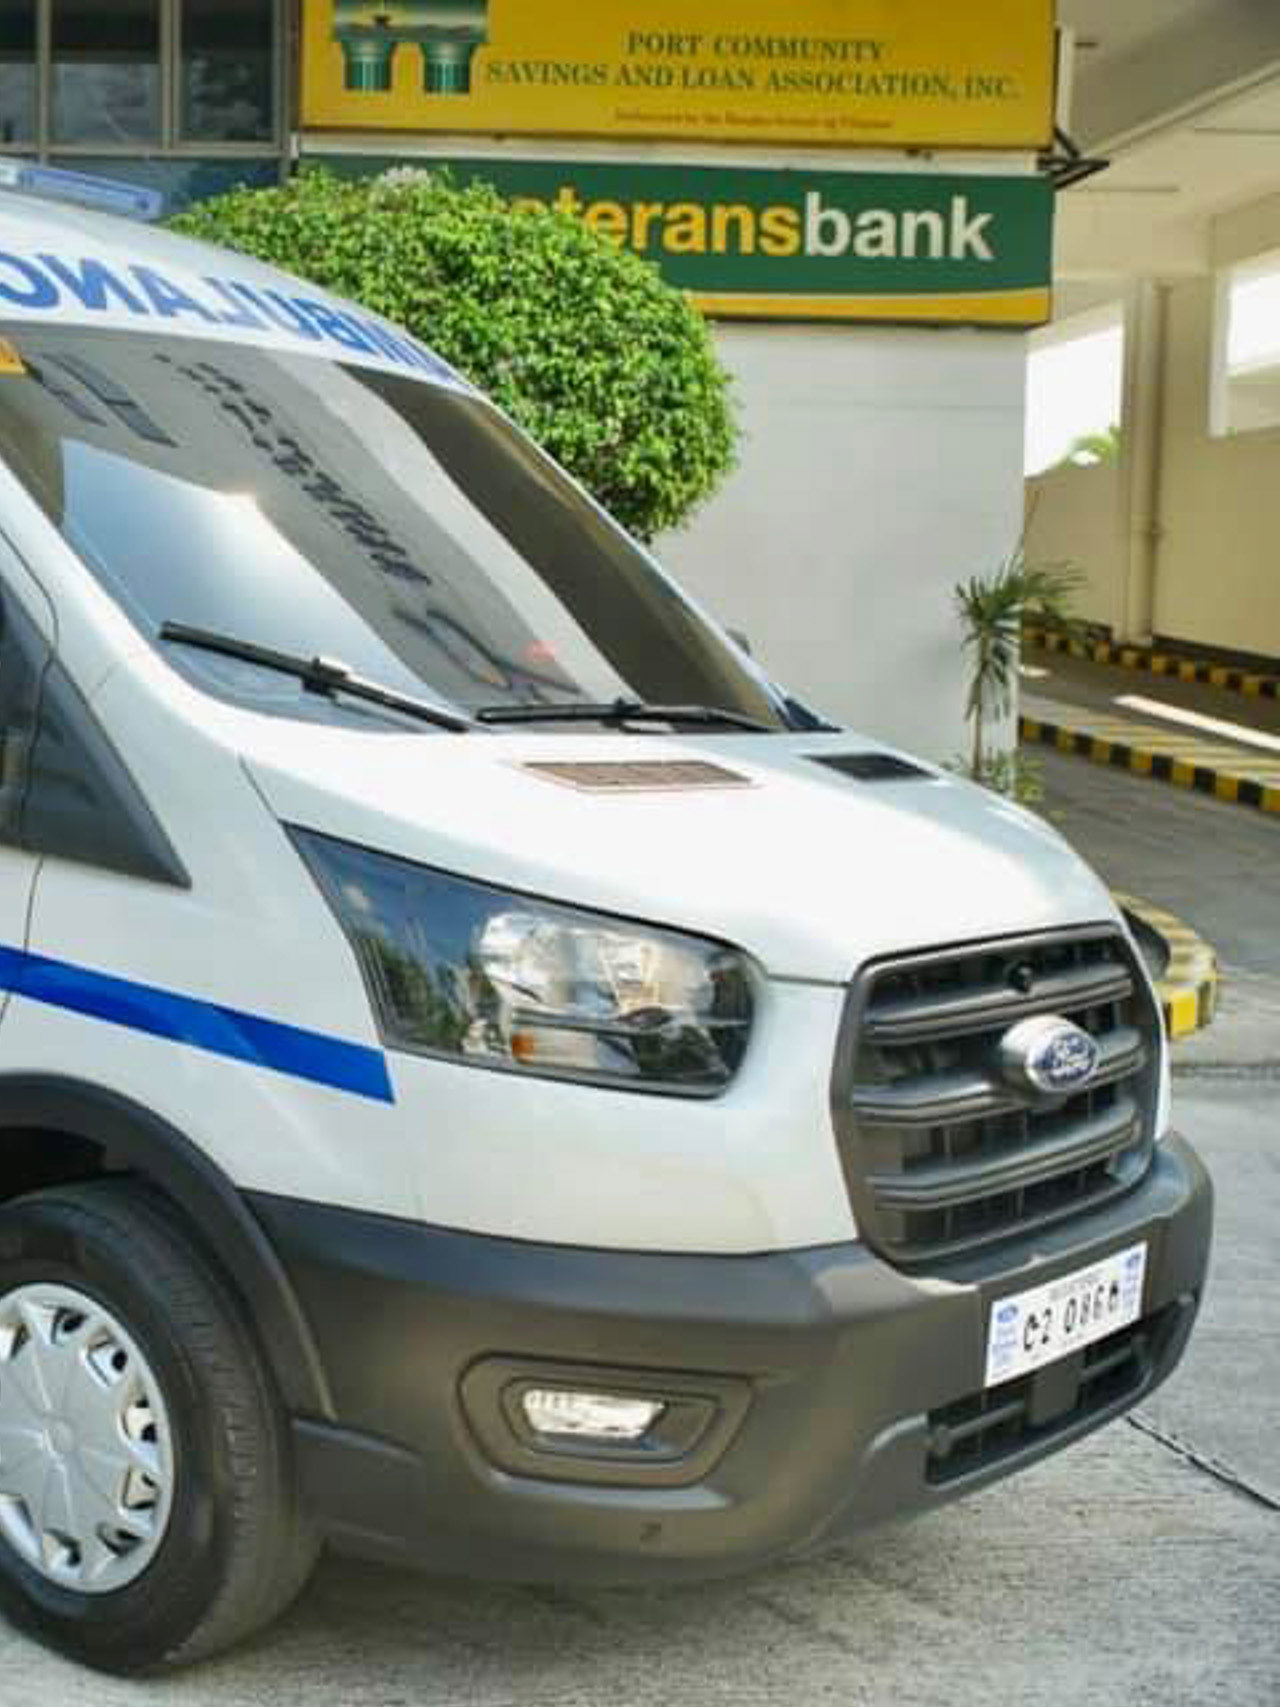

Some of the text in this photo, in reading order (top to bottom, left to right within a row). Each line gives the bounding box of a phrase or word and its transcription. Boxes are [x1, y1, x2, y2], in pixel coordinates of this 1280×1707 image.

[628, 31, 885, 60] PORT COMMUNITY
[487, 61, 1019, 99] SAVINGS AND LOAN ASSOCIATION, INC.
